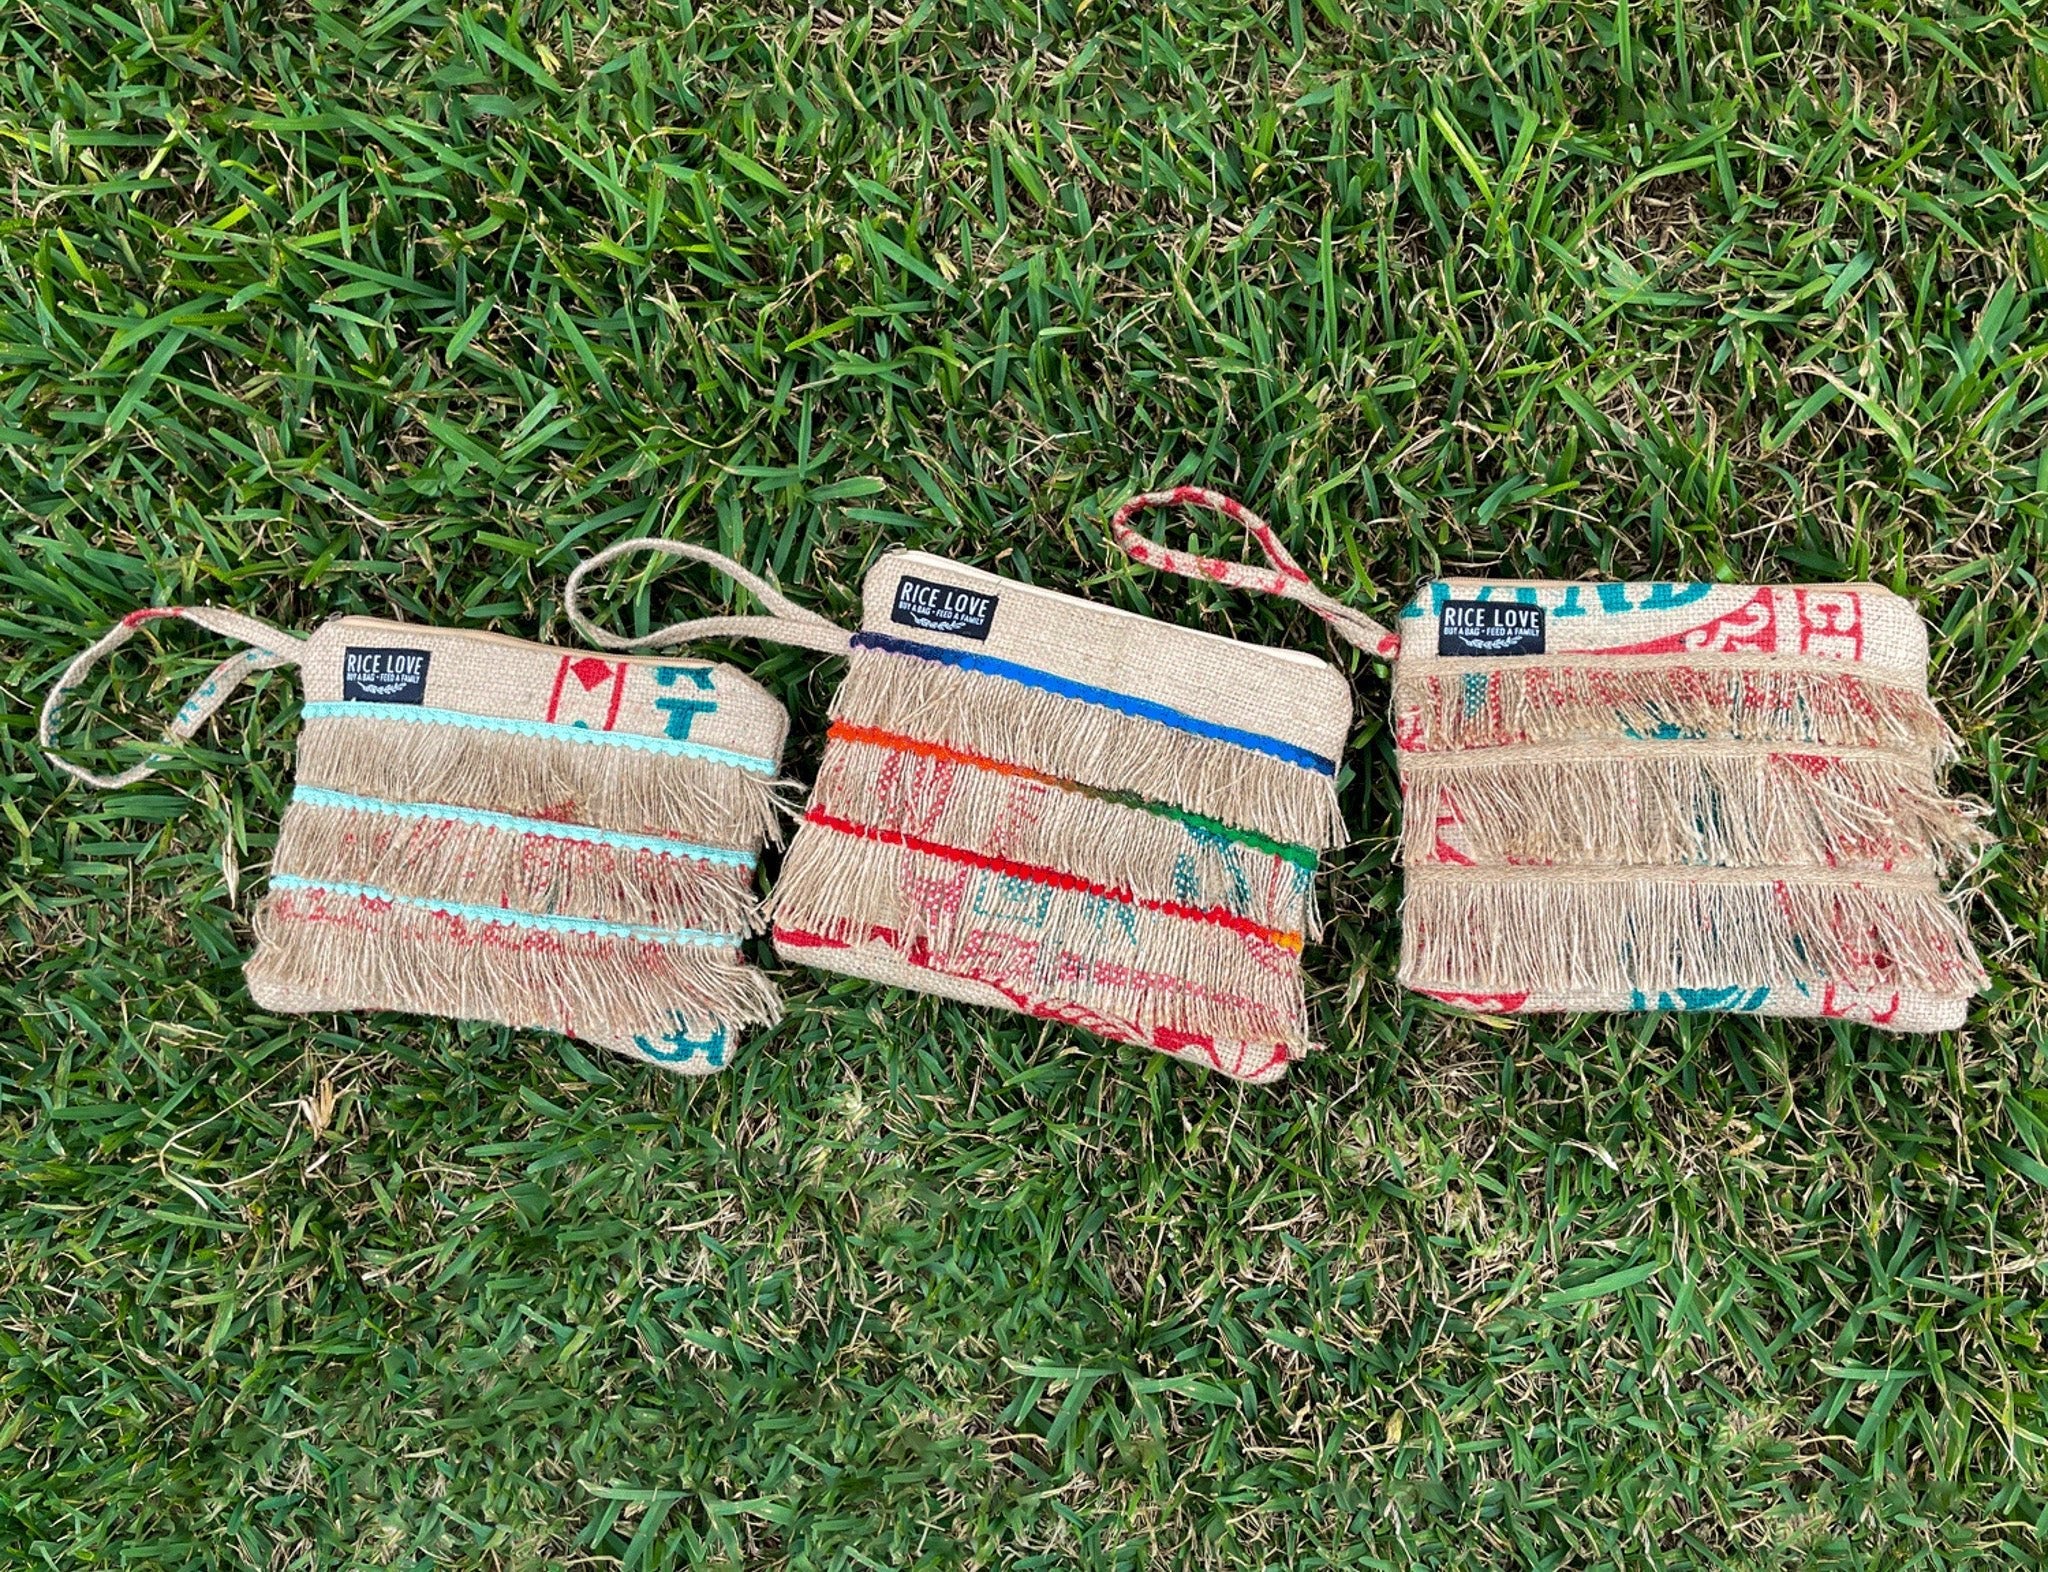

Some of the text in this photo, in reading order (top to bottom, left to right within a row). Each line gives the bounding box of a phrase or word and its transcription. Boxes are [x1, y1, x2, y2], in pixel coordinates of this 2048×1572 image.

[900, 581, 990, 617] RICE LOVE
[1444, 607, 1540, 629] RICE LOVE
[347, 653, 424, 675] RICE LOVE
